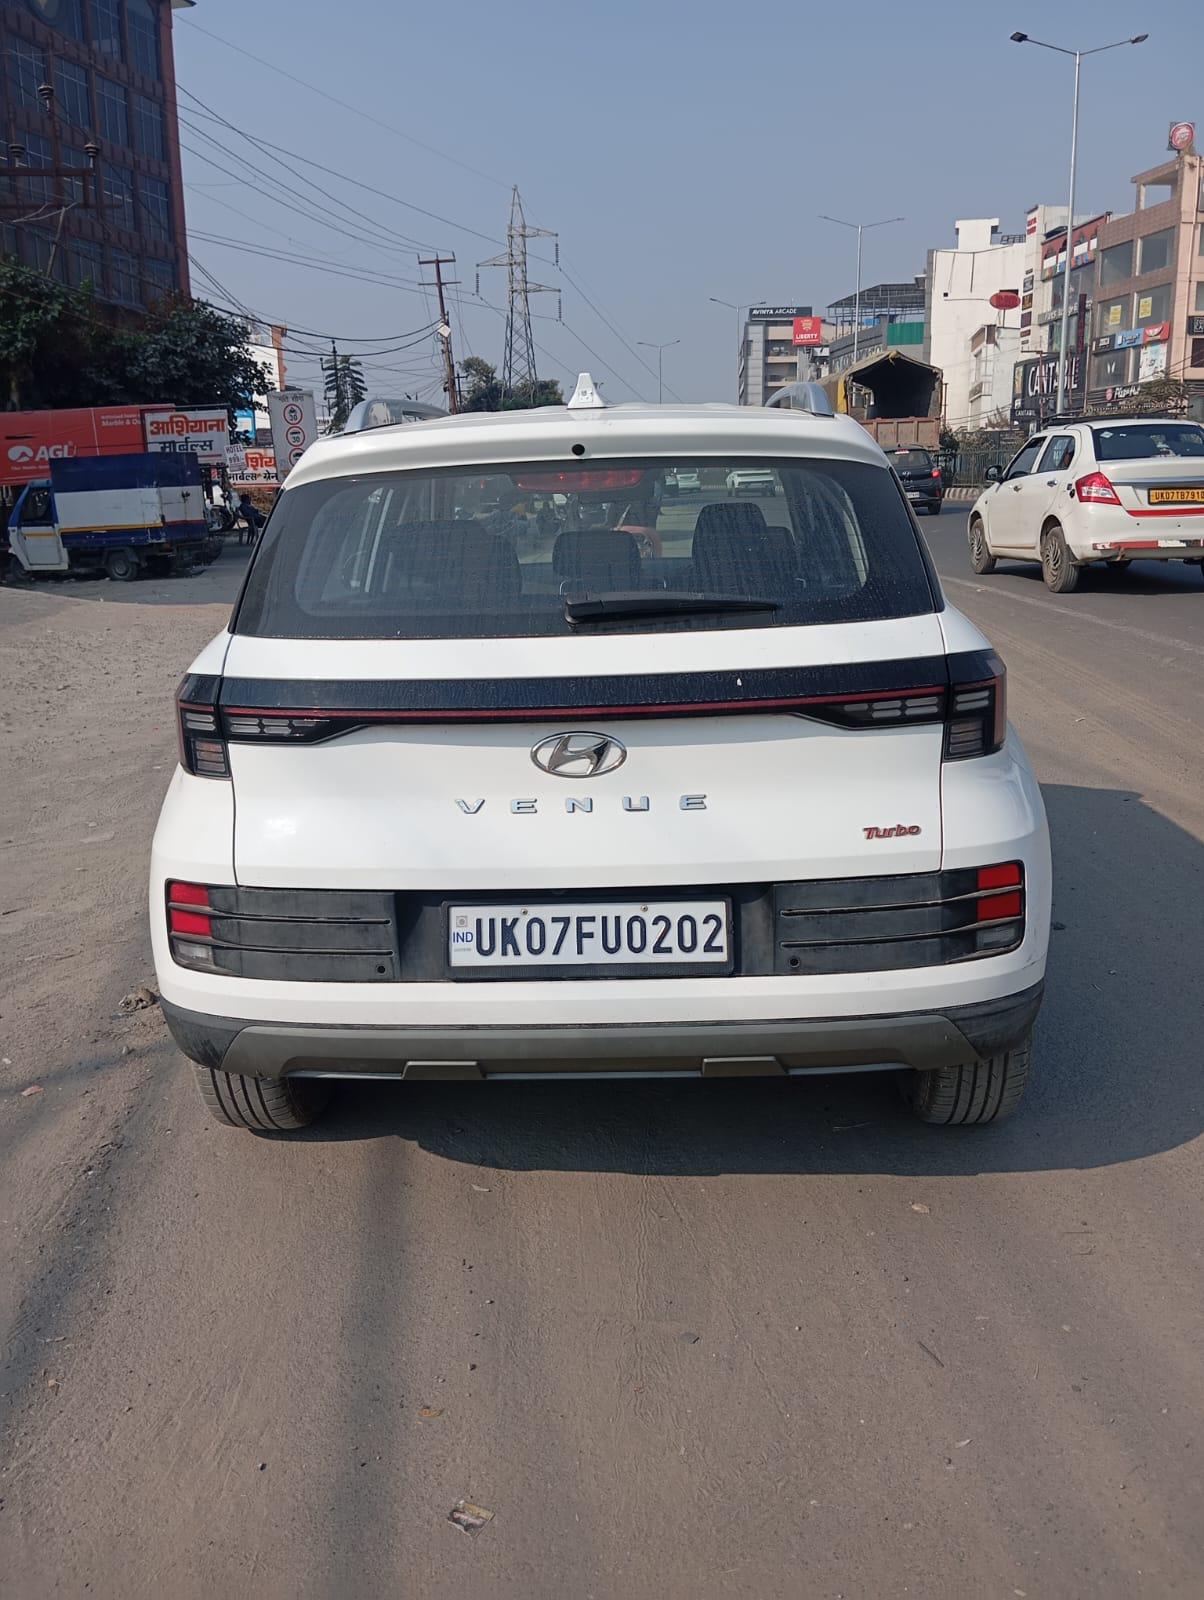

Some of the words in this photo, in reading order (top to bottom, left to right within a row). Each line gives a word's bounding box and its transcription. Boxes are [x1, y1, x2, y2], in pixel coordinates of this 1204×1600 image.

[149, 414, 226, 436] आशियाना
[35, 444, 74, 461] AGL
[160, 436, 214, 453] मार्बल्स
[225, 444, 243, 454] HOTEL
[455, 794, 708, 814] VENUE
[863, 823, 922, 840] Turbo
[453, 931, 474, 943] IND
[475, 914, 724, 957] UK07FU0202
